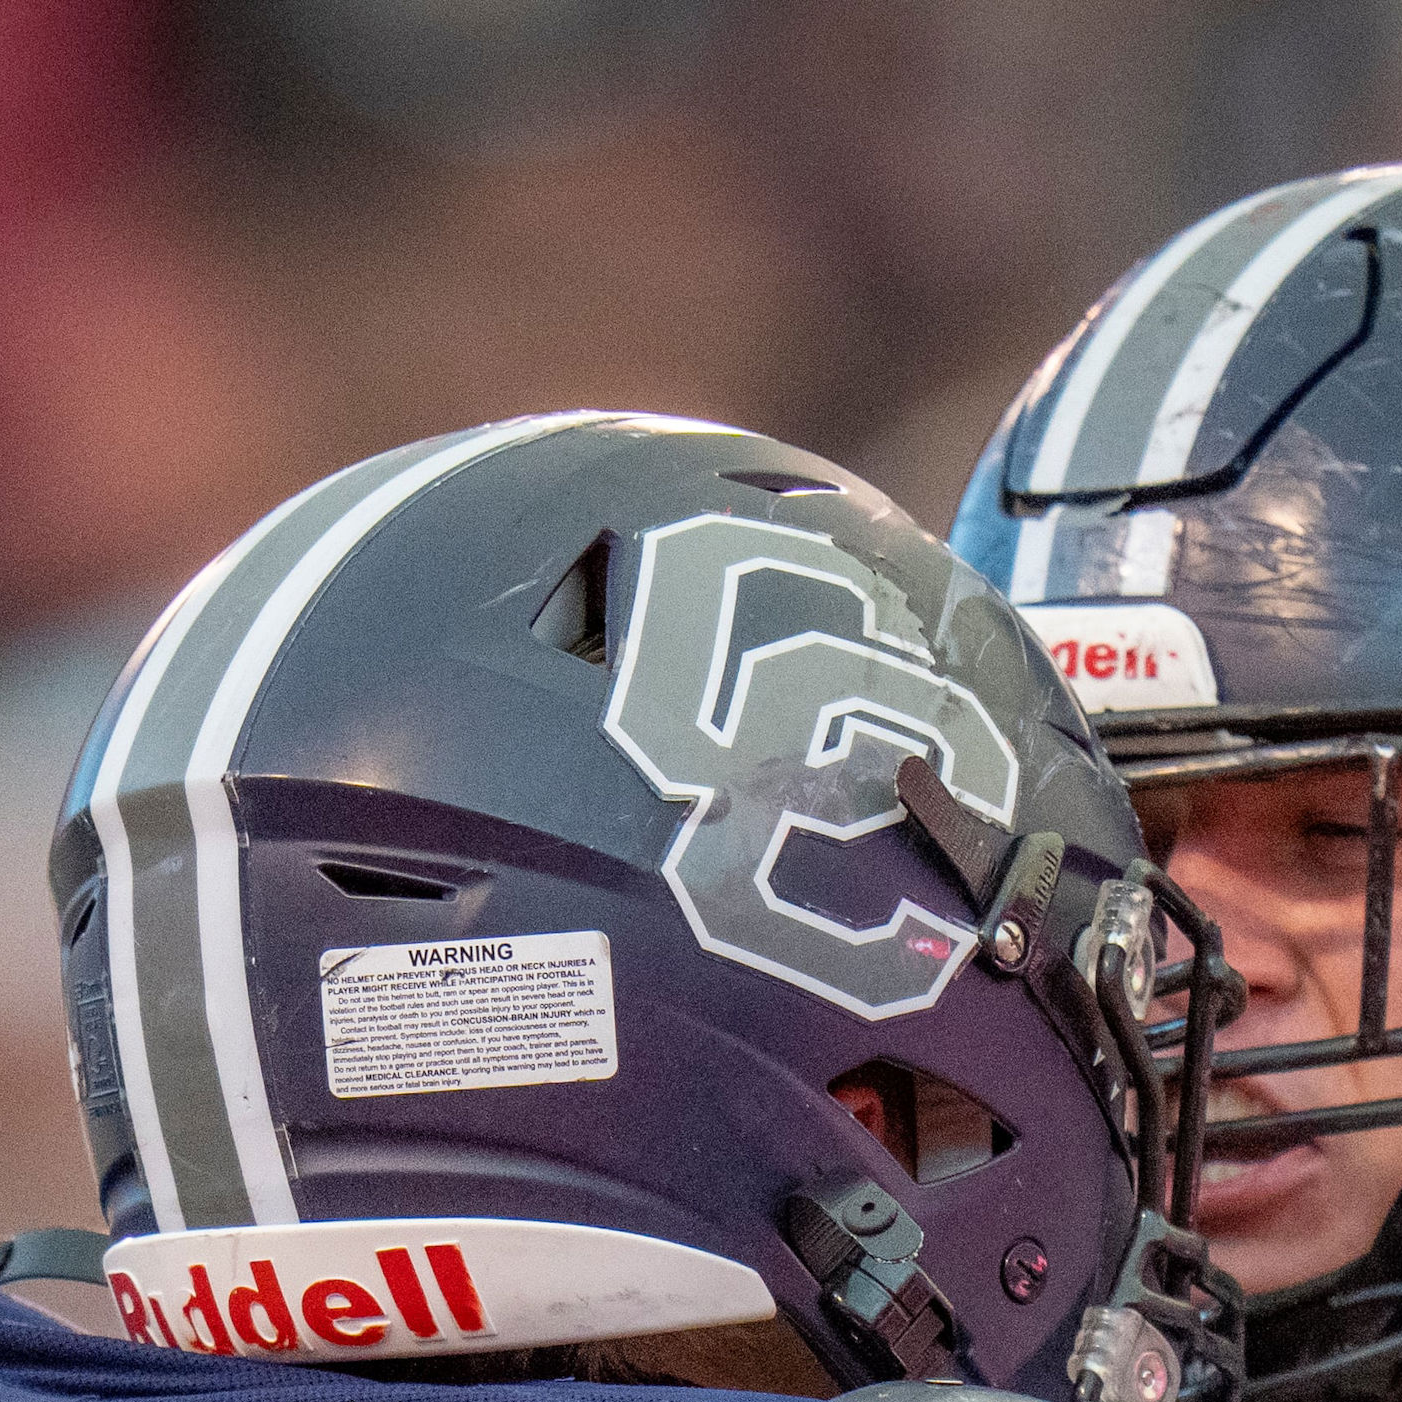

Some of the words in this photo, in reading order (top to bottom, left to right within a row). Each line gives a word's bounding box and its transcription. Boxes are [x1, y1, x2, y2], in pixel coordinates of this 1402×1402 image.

[408, 942, 512, 966] WARNING
[327, 977, 338, 985] NO
[341, 974, 374, 984] HELMET
[376, 973, 394, 981] CAN
[397, 970, 435, 979] PREVENT
[439, 967, 477, 976] SOUS
[479, 965, 503, 973] HEAD
[521, 962, 544, 970] NECK
[547, 958, 586, 968] INJURIES
[328, 986, 359, 995] PLAYER
[362, 984, 388, 992] MIGHT
[390, 981, 426, 990] RECEIVE
[429, 979, 456, 987] WHILE
[536, 969, 585, 979] FOOTBALL.
[407, 1001, 423, 1009] rules
[576, 988, 593, 996] neck
[501, 984, 534, 993] opposing
[536, 982, 558, 990] player.
[330, 1017, 356, 1025] injuries,
[357, 1014, 387, 1023] paralysis
[459, 1006, 489, 1015] possible
[491, 1005, 511, 1013] injury
[521, 1003, 537, 1011] your
[539, 1000, 575, 1010] opponent.
[340, 1025, 366, 1033] Contact
[377, 1023, 401, 1031] football
[450, 1012, 537, 1025] CONCUSSION-BRAIN
[540, 1009, 571, 1019] INJURY
[573, 1008, 594, 1016] which
[332, 1045, 364, 1053] dizziness,
[367, 1043, 402, 1051] headache,
[442, 1037, 478, 1045] confusion.
[522, 1031, 560, 1041] symptoms,
[370, 1034, 397, 1042] prevent.
[400, 1030, 437, 1040] Symptoms
[439, 1028, 464, 1036] include:
[494, 1023, 546, 1032] consciousness
[558, 1020, 589, 1029] memory,
[333, 1055, 372, 1064] immediately
[392, 1052, 416, 1060] playing
[434, 1049, 455, 1057] report
[503, 1043, 526, 1051] coach,
[529, 1041, 552, 1049] trainer
[569, 1038, 597, 1047] parents.
[395, 1062, 414, 1070] game
[425, 1058, 453, 1067] practice
[482, 1054, 518, 1063] symptoms
[570, 1049, 583, 1057] you
[335, 1075, 363, 1083] received
[365, 1071, 401, 1081] MEDICAL
[405, 1067, 458, 1078] CLEARANCE.
[461, 1066, 490, 1076] Ignoring
[507, 1062, 535, 1072] warning
[554, 1059, 570, 1067] lead
[581, 1057, 607, 1065] another
[405, 1080, 420, 1088] fatal
[442, 1078, 461, 1087] injury.
[108, 1241, 488, 1356] Riddell
